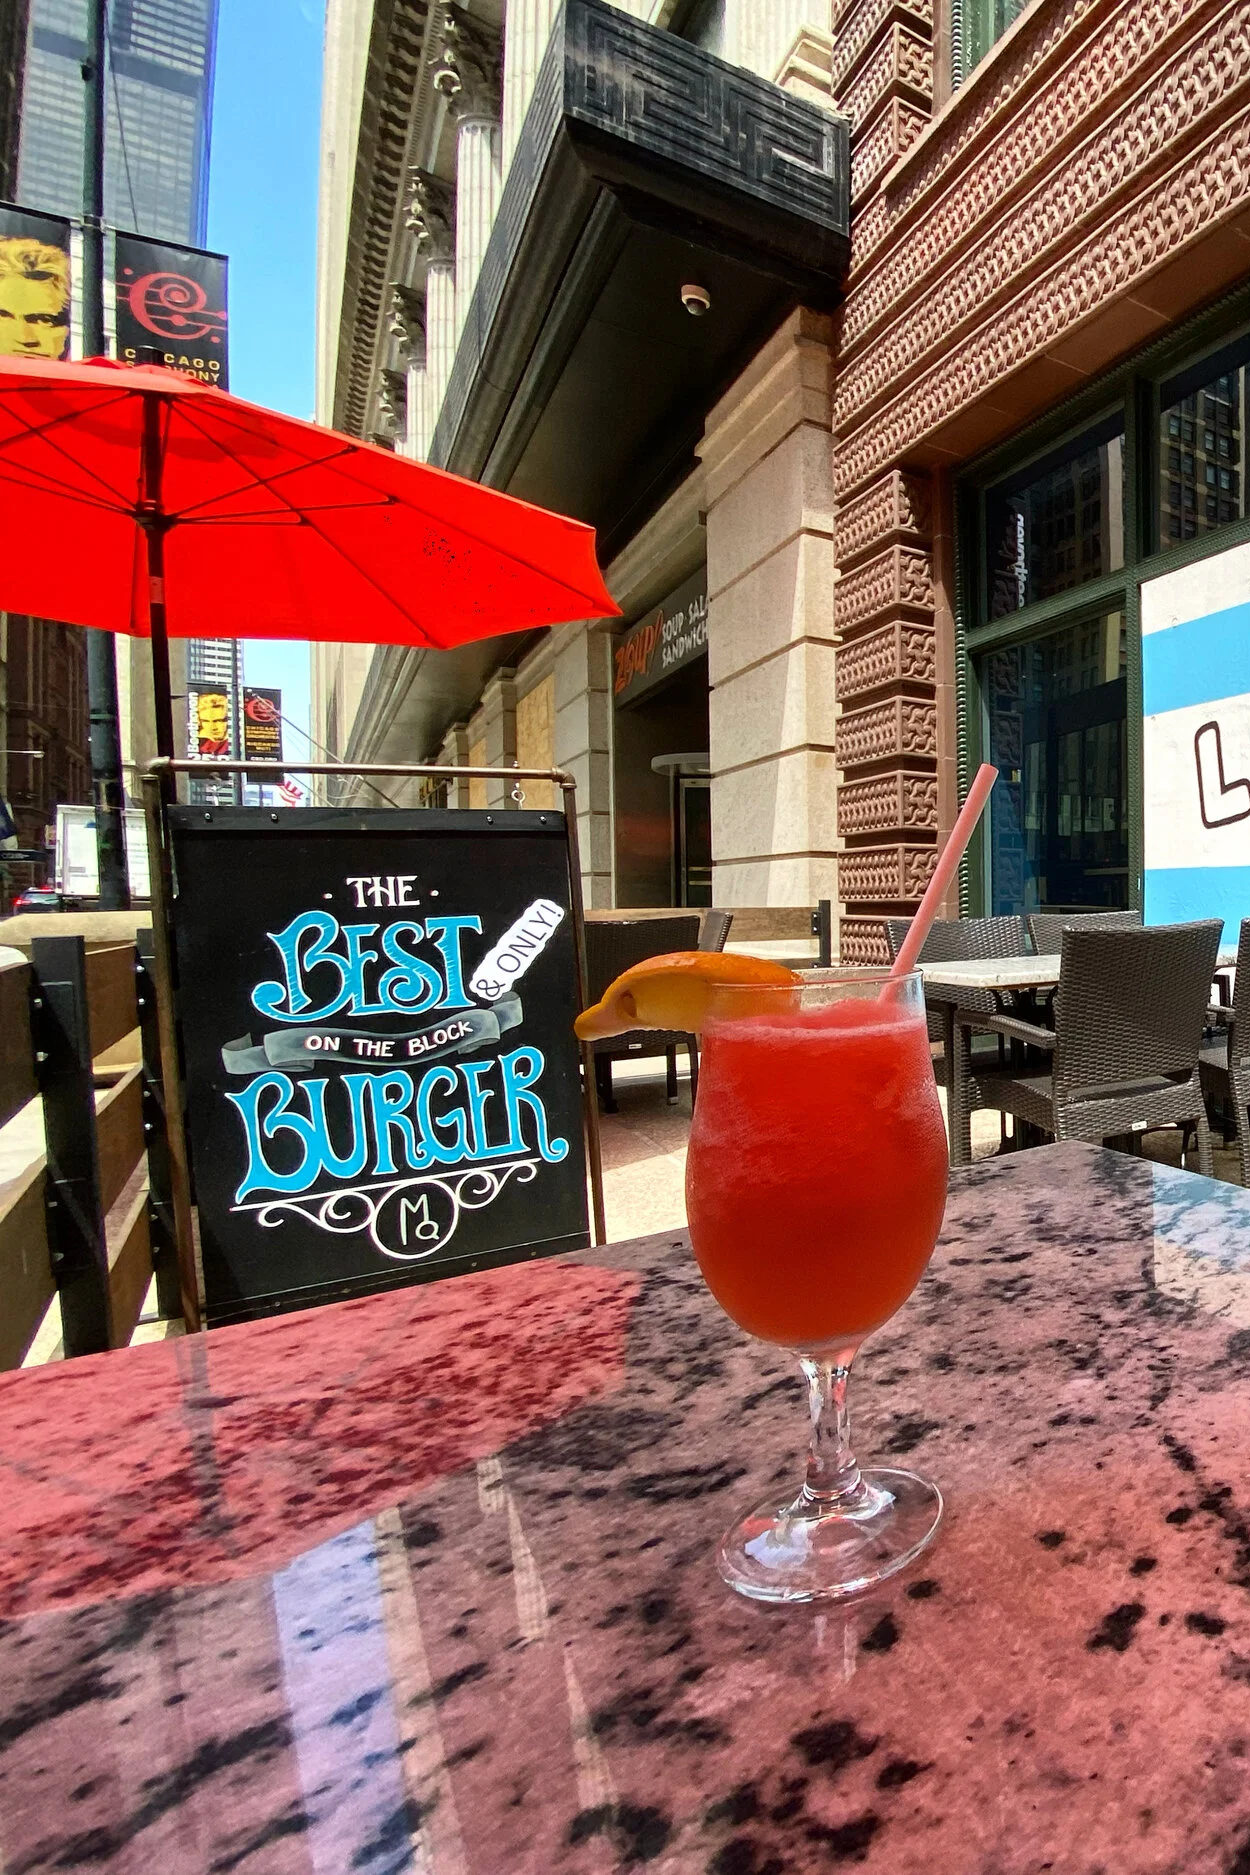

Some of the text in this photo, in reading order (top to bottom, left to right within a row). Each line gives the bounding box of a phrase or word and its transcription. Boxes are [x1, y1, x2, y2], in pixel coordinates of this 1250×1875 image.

[124, 348, 220, 371] CCAGO
[662, 595, 708, 644] SOUP SAL
[346, 875, 421, 908] THE
[251, 910, 483, 1023] BEST
[476, 903, 562, 998] & ONLY!
[304, 1020, 474, 1058] ON THE BLOCK
[224, 1045, 570, 1205] BURGER
